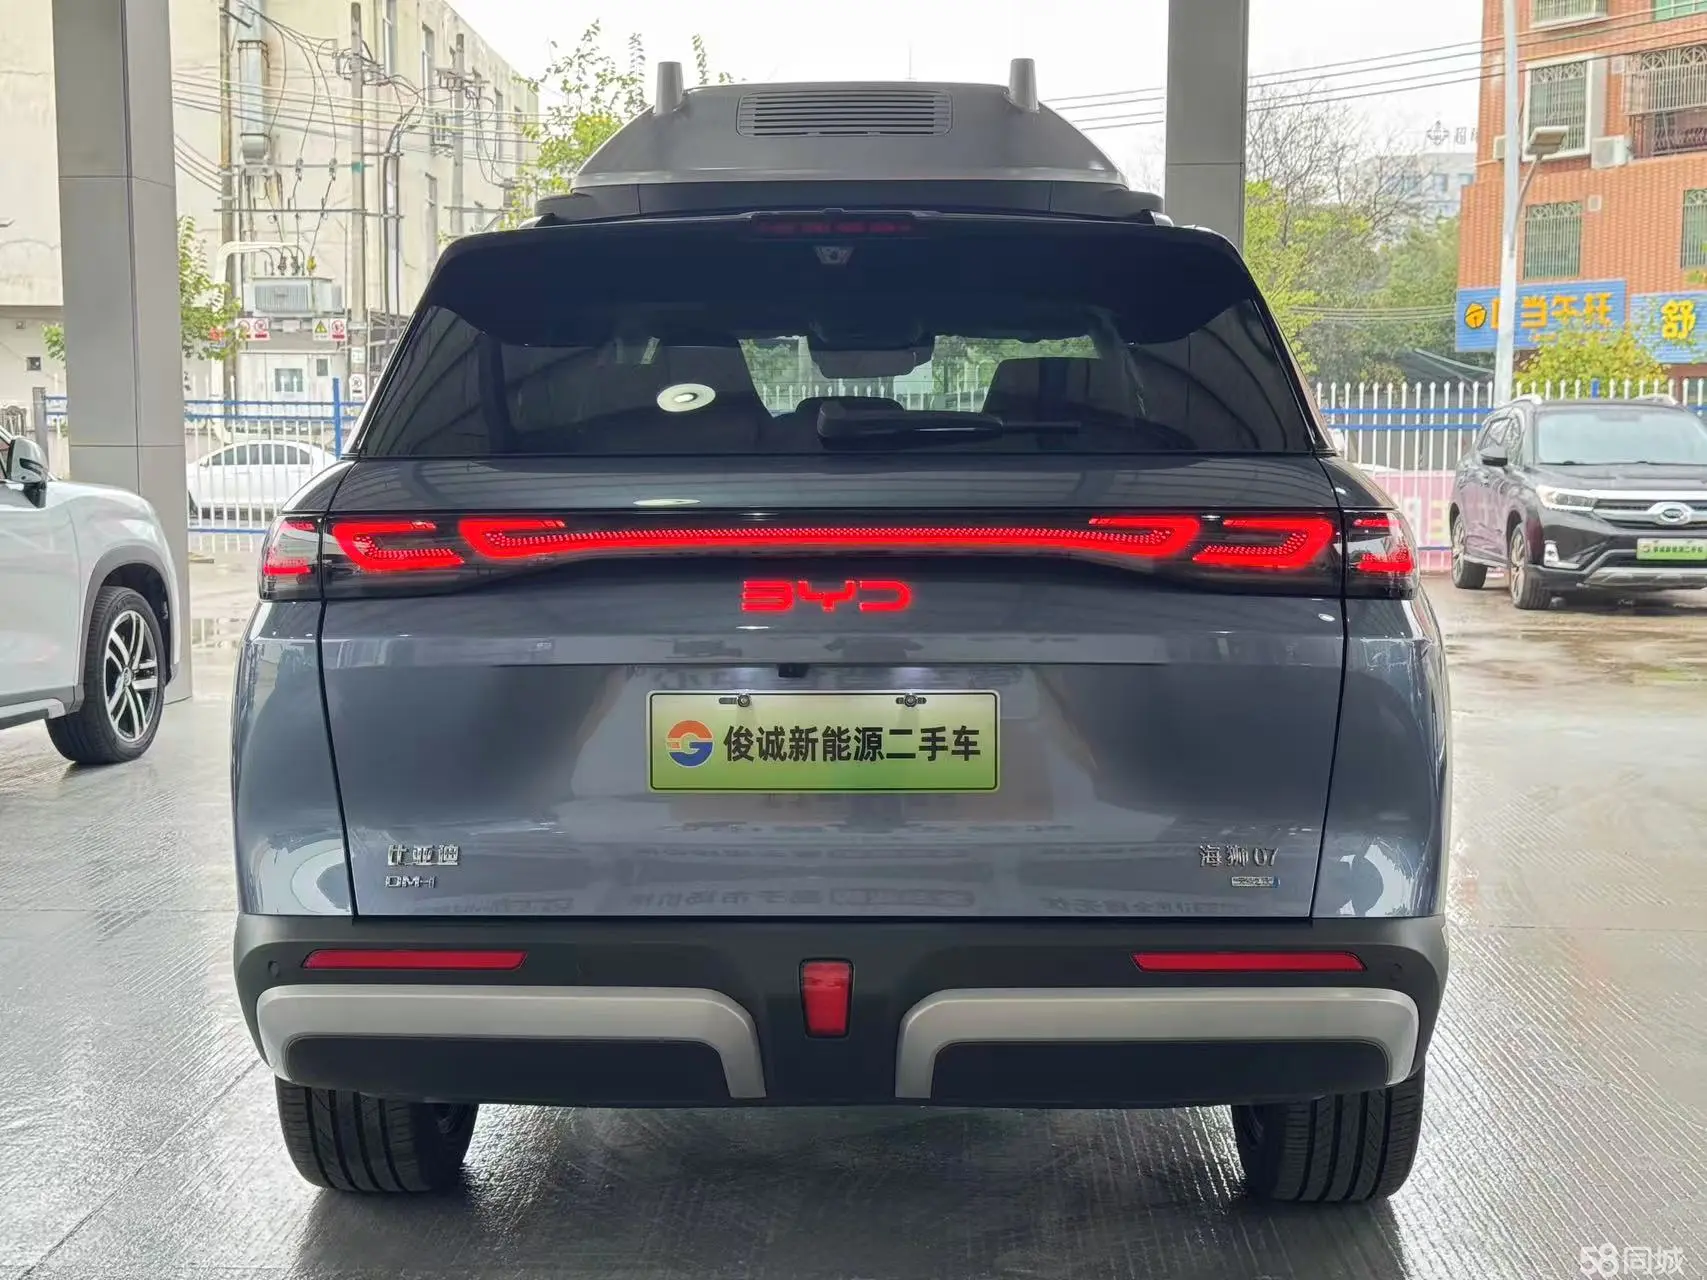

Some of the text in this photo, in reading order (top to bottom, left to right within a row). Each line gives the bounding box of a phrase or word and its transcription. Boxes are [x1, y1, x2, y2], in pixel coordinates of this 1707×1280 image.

[1661, 299, 1696, 340] 舒
[741, 580, 913, 613] BYD
[723, 724, 982, 763] 俊诚新能源二手车
